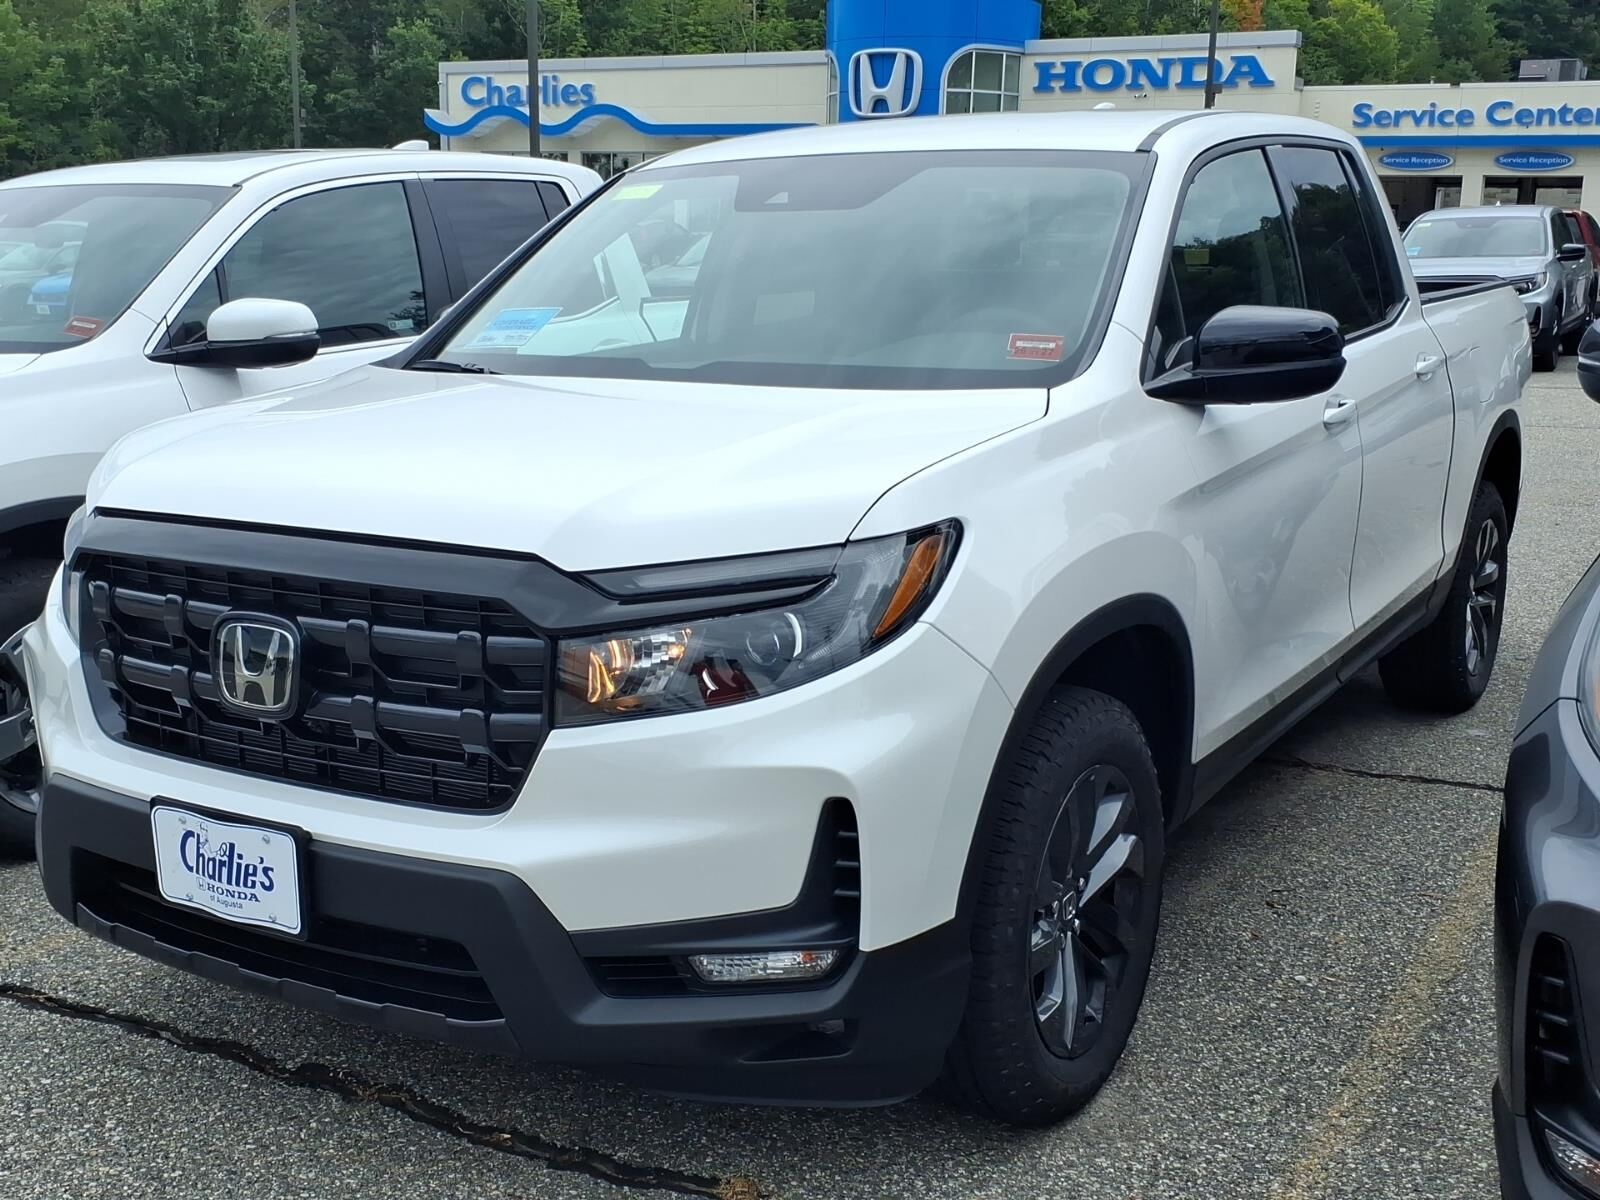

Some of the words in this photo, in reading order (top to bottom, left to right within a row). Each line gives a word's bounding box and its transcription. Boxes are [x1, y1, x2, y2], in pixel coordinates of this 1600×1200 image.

[1033, 55, 1275, 93] HONDA
[1352, 102, 1475, 128] Service
[1383, 156, 1409, 164] Service
[1411, 156, 1448, 165] Reception
[1499, 156, 1527, 164] Service
[1529, 156, 1568, 165] Reception
[180, 830, 275, 892] Charlie's
[207, 882, 261, 903] HONDA
[216, 896, 244, 909] Augusta
